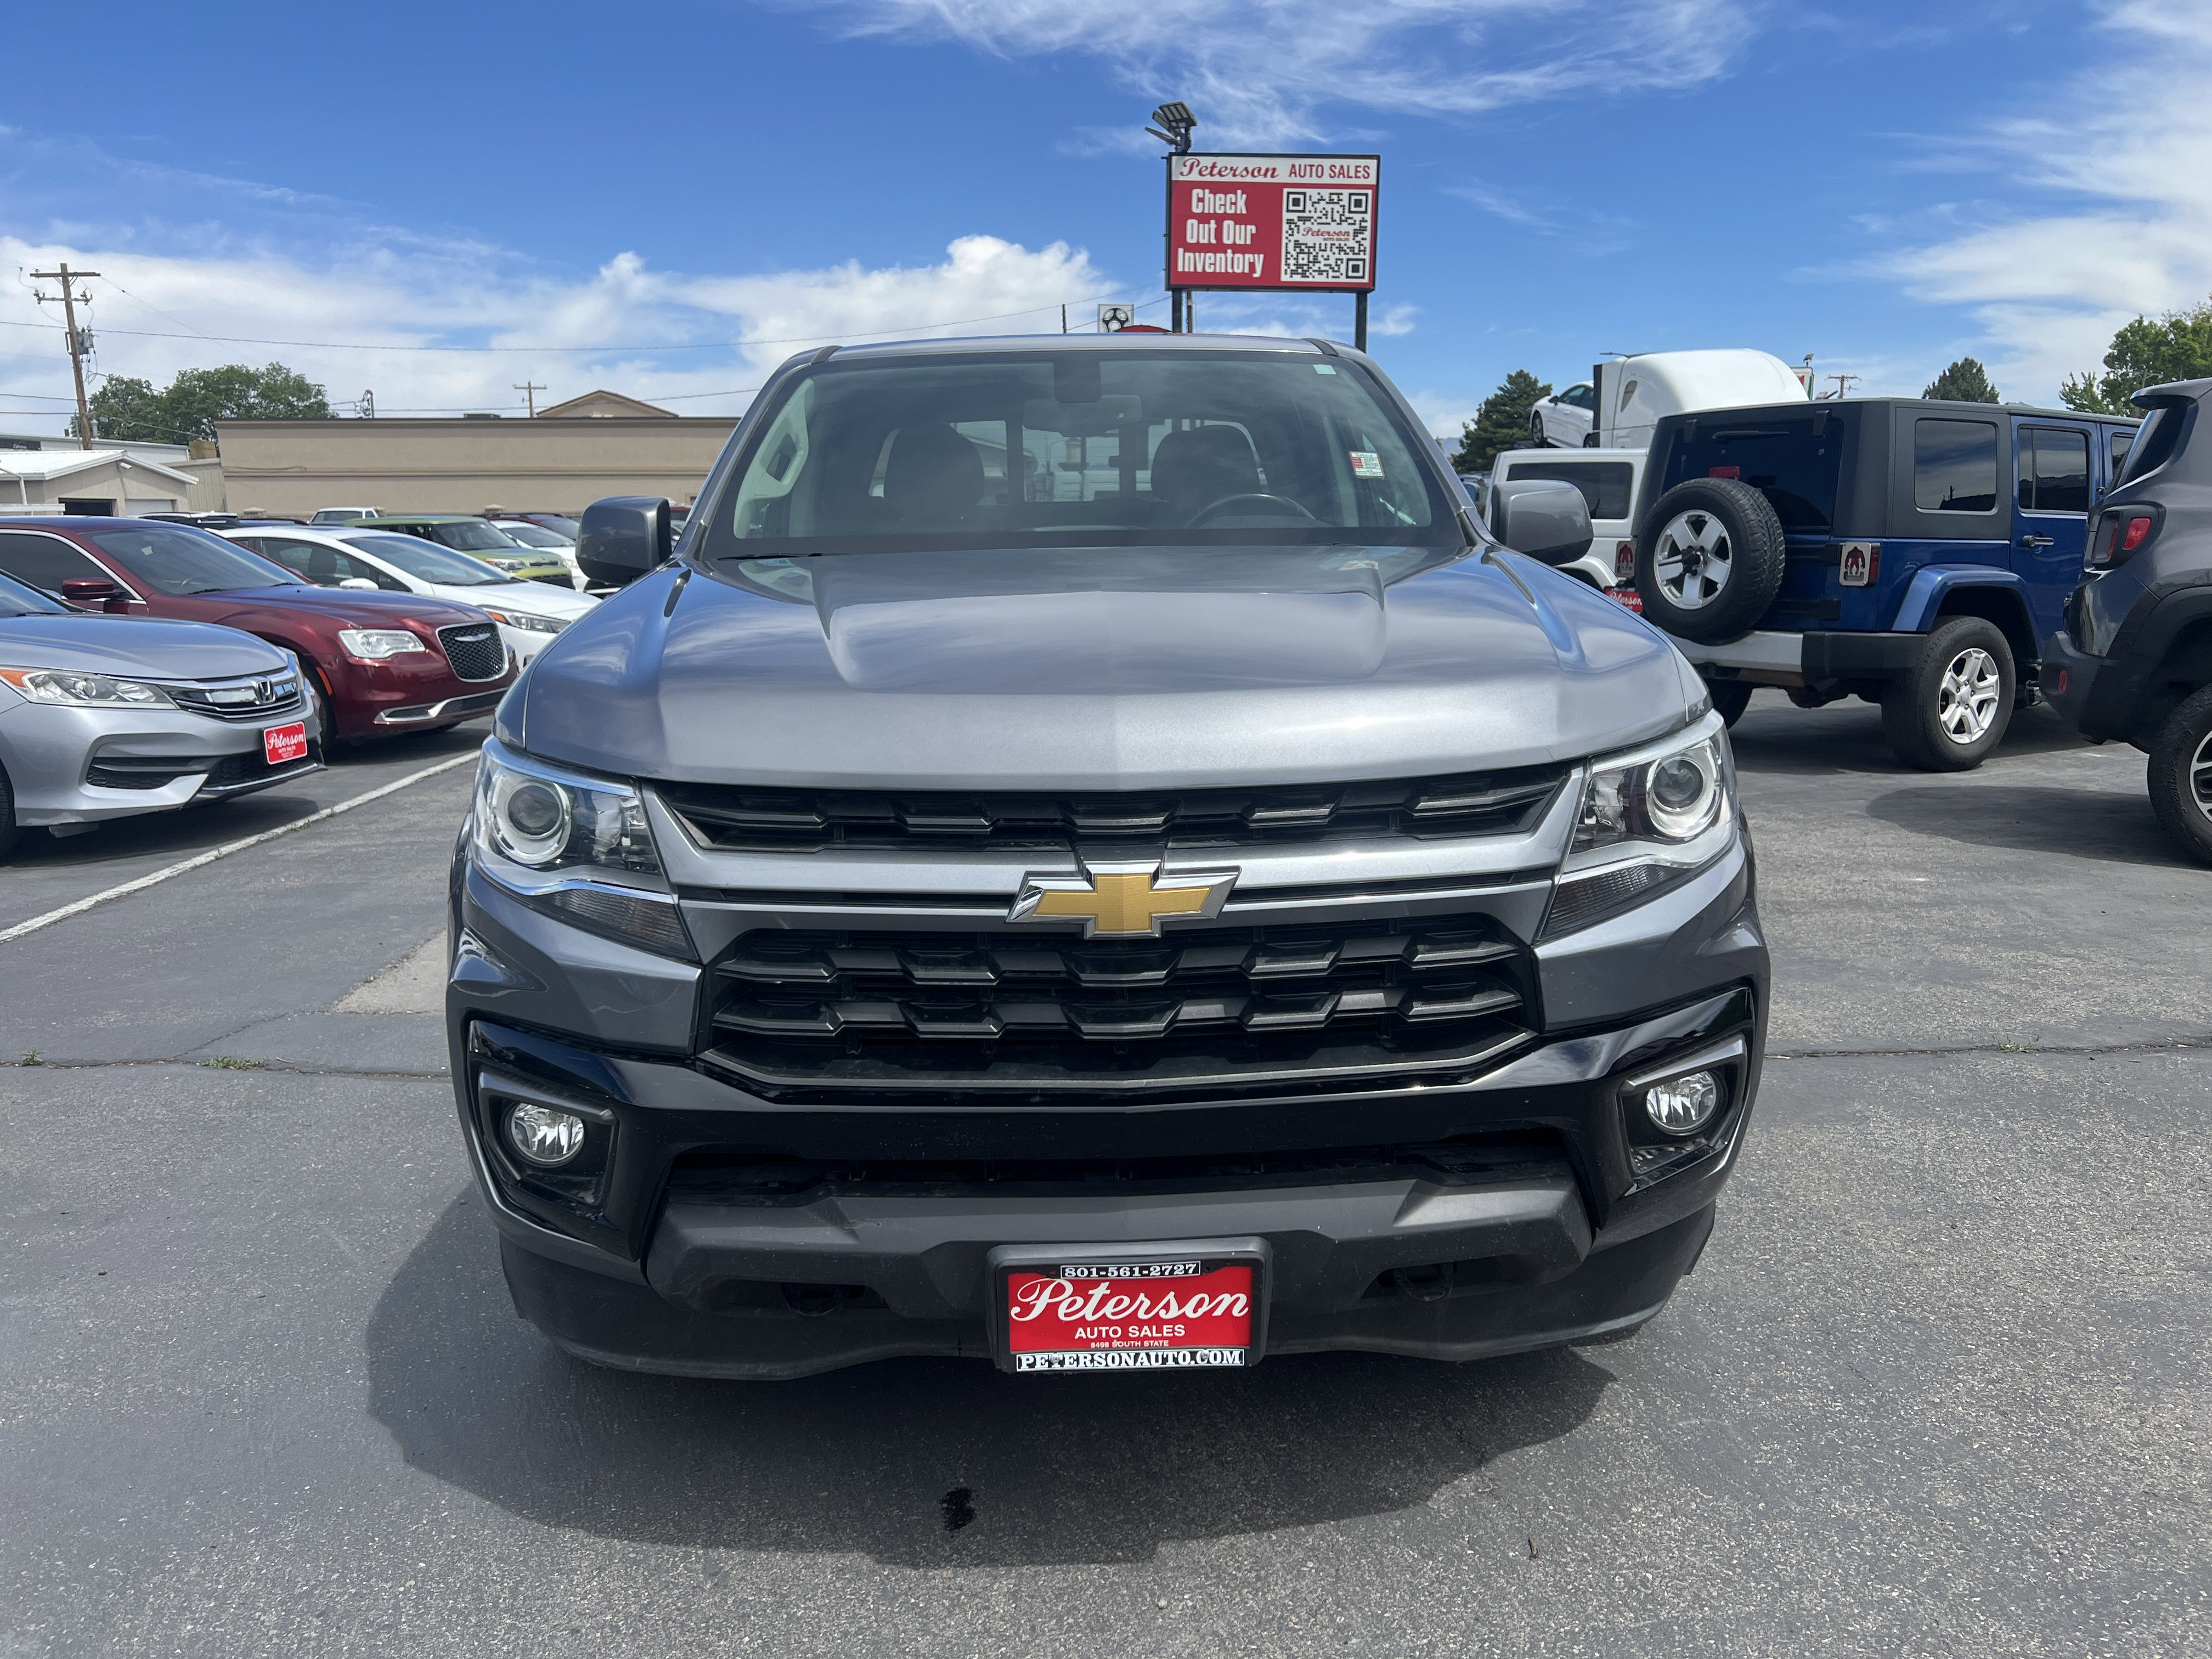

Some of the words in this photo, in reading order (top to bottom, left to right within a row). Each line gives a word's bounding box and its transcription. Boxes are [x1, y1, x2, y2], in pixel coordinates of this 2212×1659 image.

[1180, 158, 1279, 179] Peterson
[1289, 164, 1324, 178] AUTO
[1328, 164, 1370, 179] SALES
[1191, 189, 1247, 214] Check
[1186, 219, 1217, 244] Out
[1222, 220, 1256, 245] Our
[1301, 227, 1350, 236] Peterson
[1177, 248, 1264, 278] Inventory
[267, 733, 304, 750] Peterson
[1064, 1263, 1197, 1277] 801-561-2727
[1011, 1278, 1249, 1322] Peterson
[1075, 1326, 1122, 1339] AUTO
[1128, 1324, 1186, 1338] SALES
